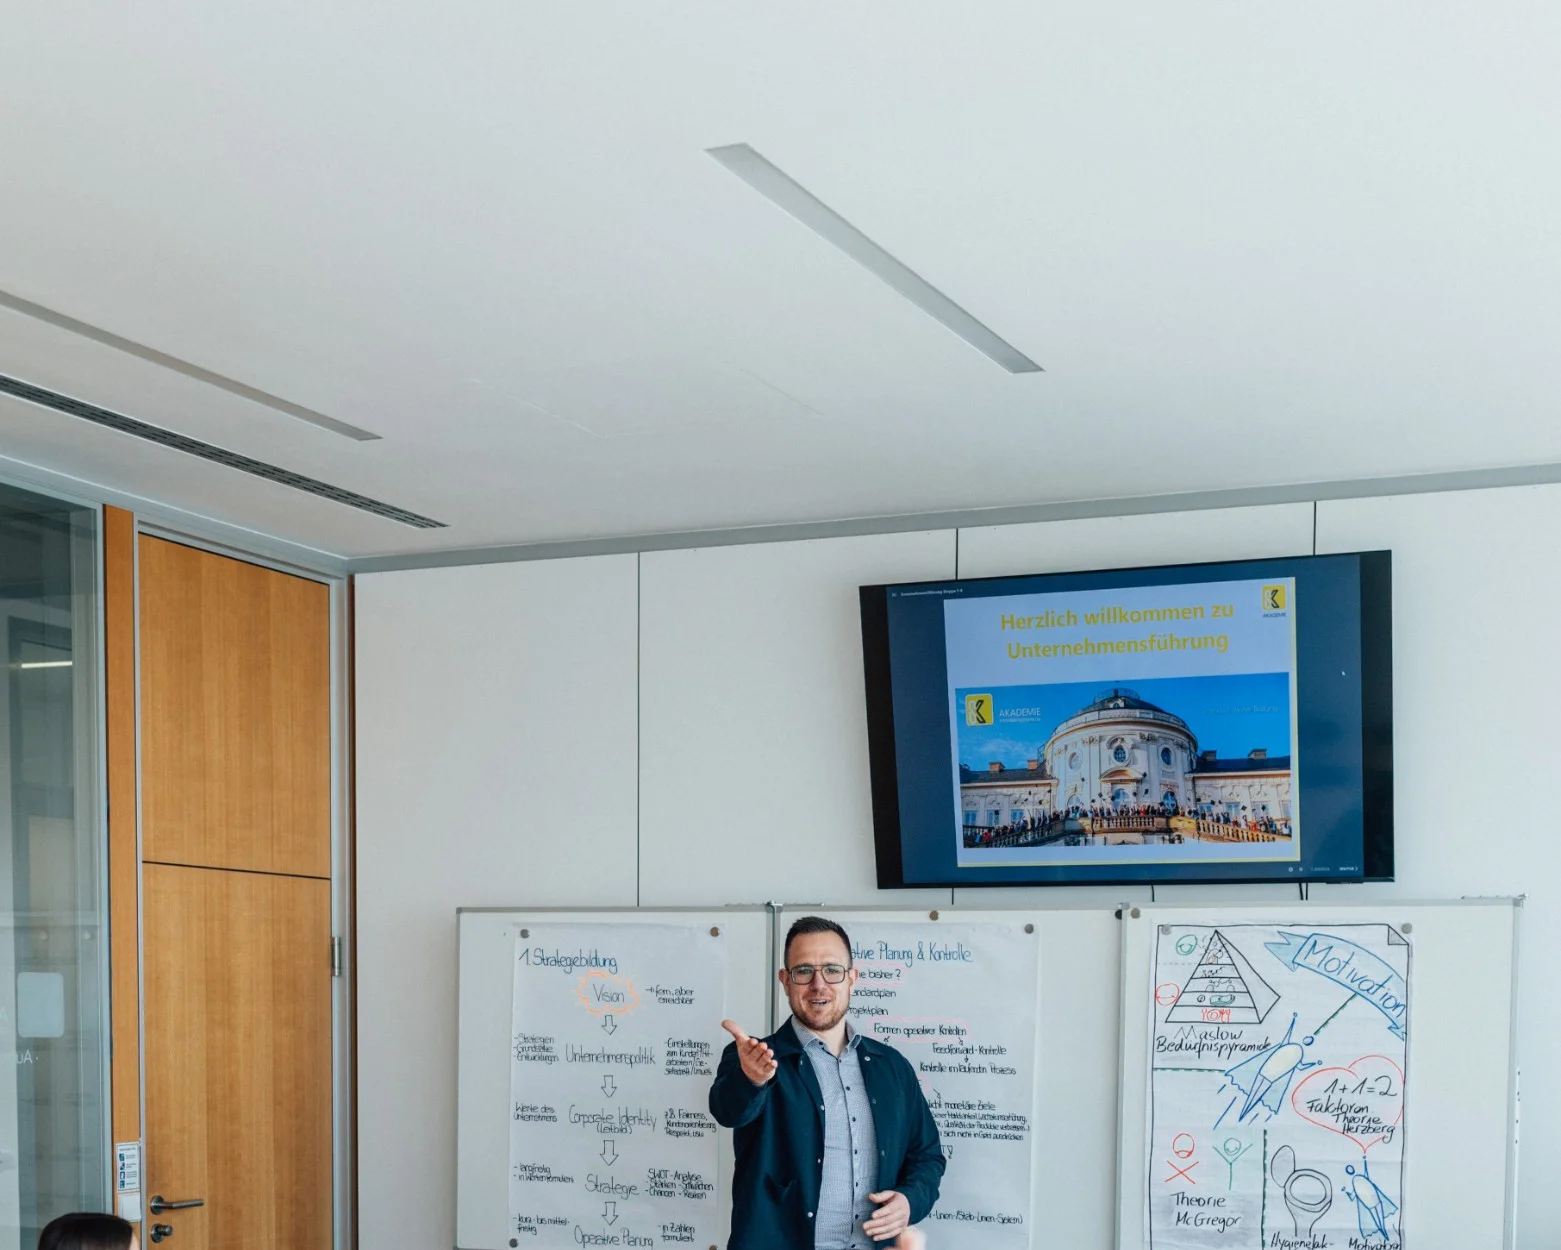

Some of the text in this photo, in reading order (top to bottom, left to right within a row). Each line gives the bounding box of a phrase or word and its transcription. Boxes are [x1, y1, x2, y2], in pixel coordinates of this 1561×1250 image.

[1001, 603, 1234, 630] Herzlich willkommen zu
[1007, 634, 1229, 660] Unternehmensführung
[999, 707, 1041, 717] AKADEMIE
[533, 948, 618, 974] Strategiebildung
[877, 941, 913, 967] Planung
[917, 941, 925, 961] &
[929, 941, 974, 962] Kontrolle
[1303, 940, 1406, 1019] Motivation
[593, 983, 625, 1002] Vision
[675, 986, 694, 996] aber
[874, 1023, 901, 1035] Formen
[1174, 1025, 1243, 1040] Maslow
[565, 1043, 657, 1069] Unternehmenspolitik
[989, 1062, 1017, 1075] Prozess
[569, 1104, 657, 1131] Corporate Identity
[1332, 1111, 1383, 1124] Theorie
[1343, 1123, 1395, 1144] Herzberg
[585, 1173, 640, 1199] Strategie
[1170, 1191, 1226, 1208] Theorie
[1176, 1212, 1242, 1233] McGregor
[574, 1225, 620, 1248] Operative
